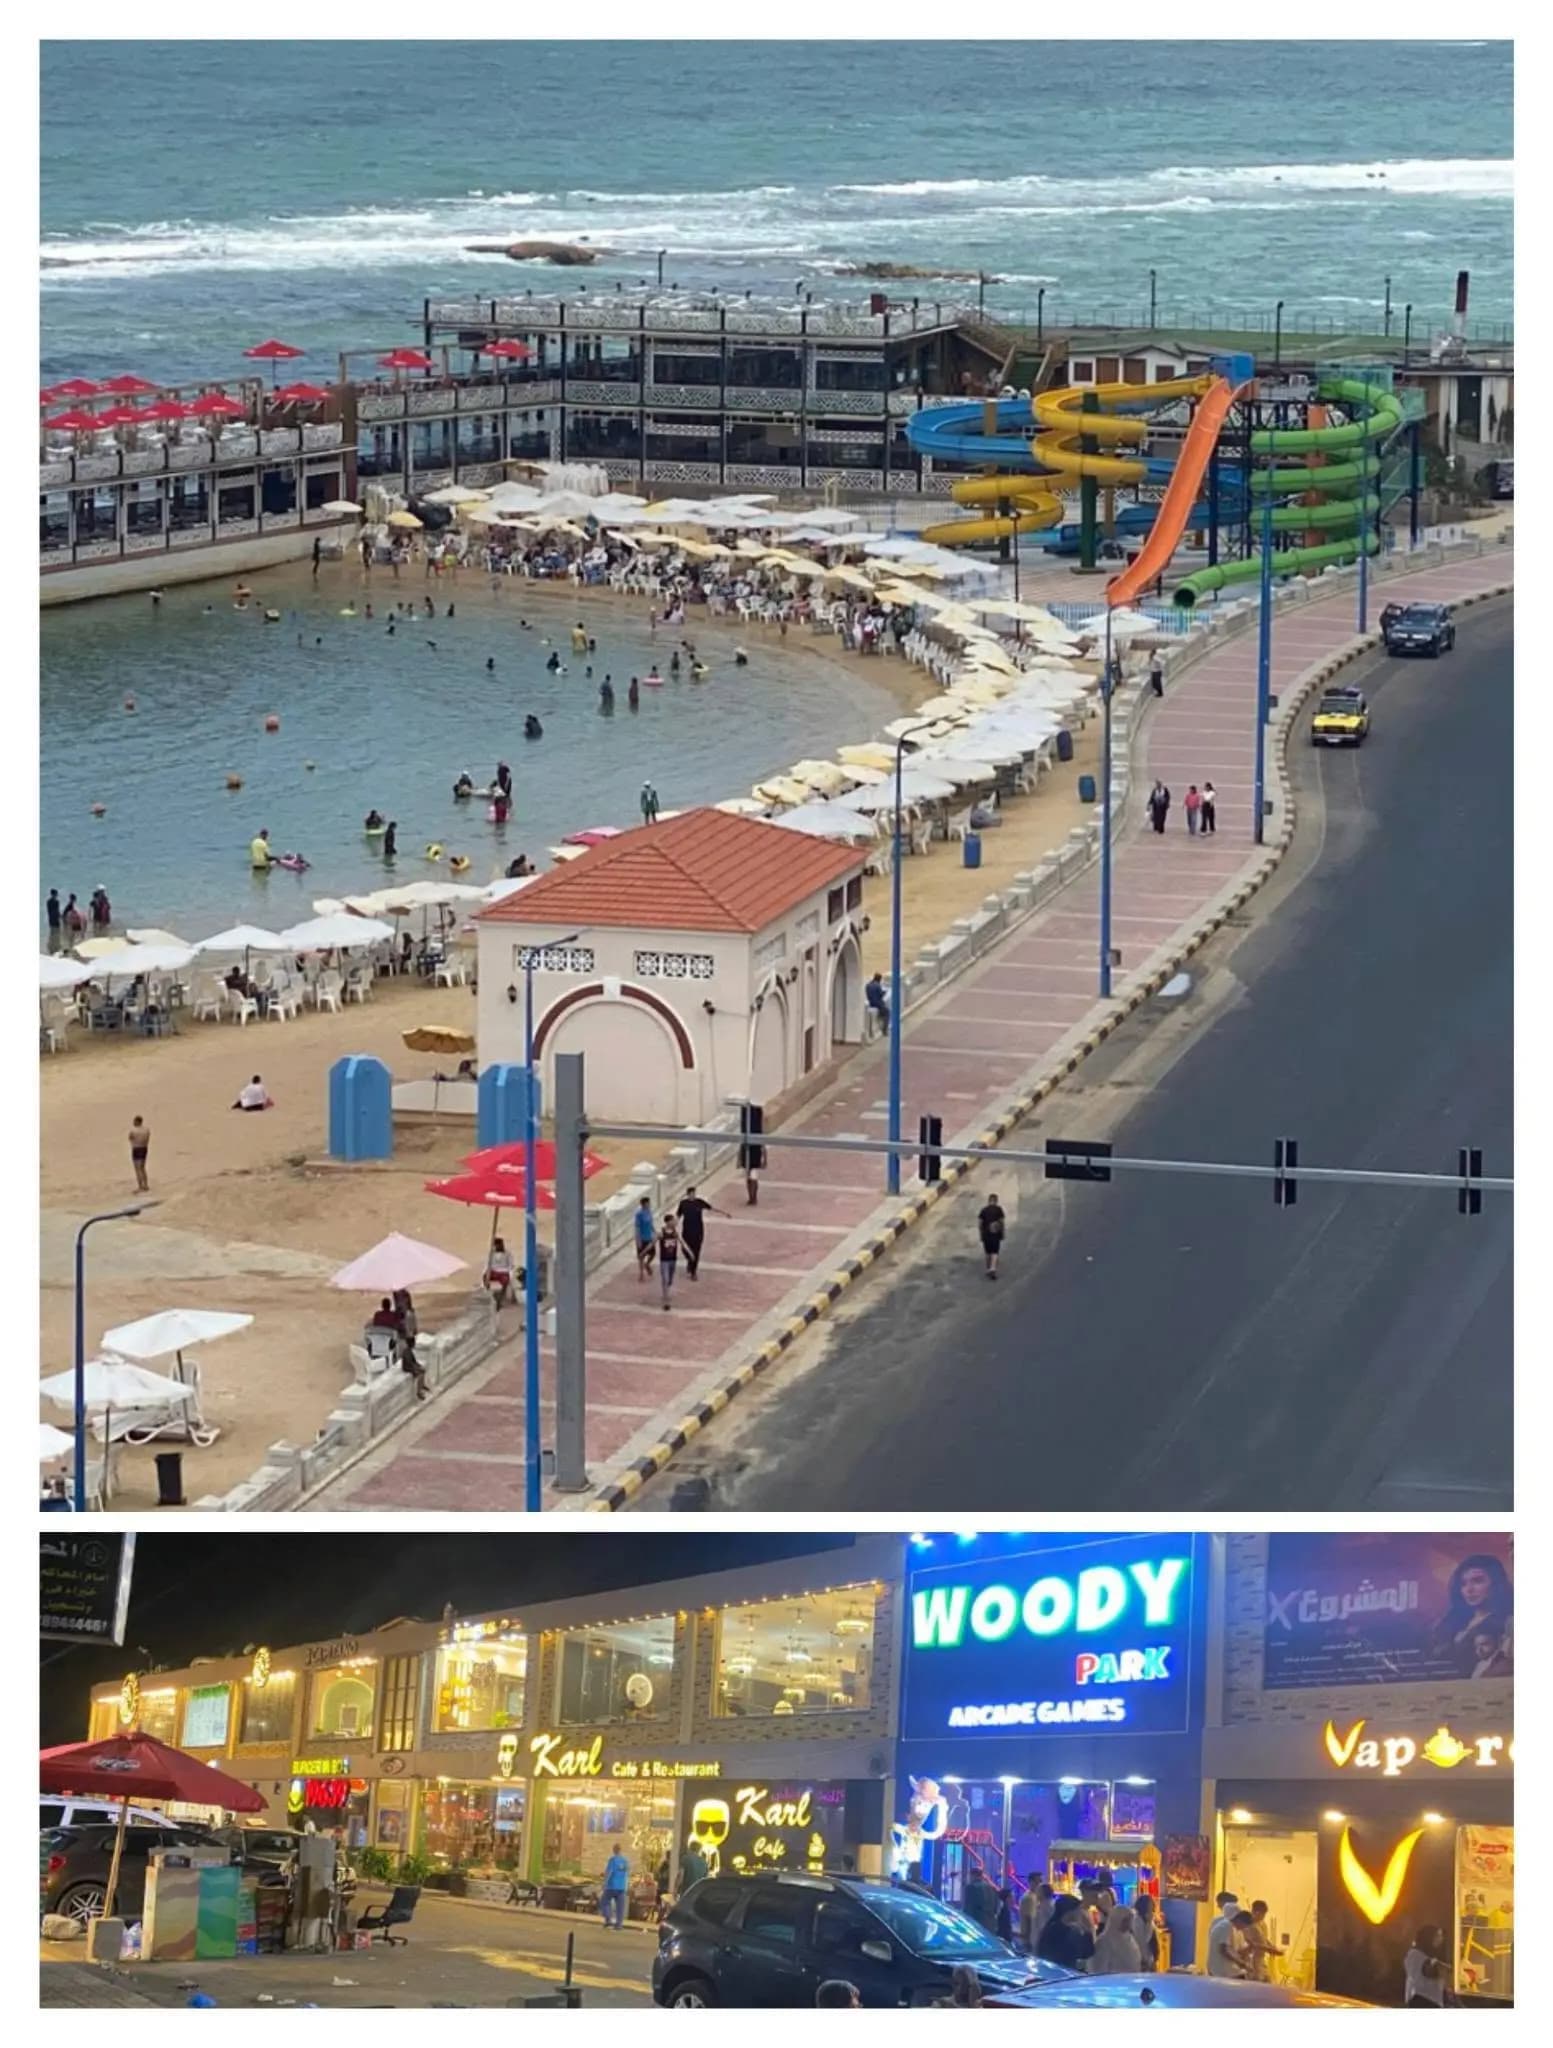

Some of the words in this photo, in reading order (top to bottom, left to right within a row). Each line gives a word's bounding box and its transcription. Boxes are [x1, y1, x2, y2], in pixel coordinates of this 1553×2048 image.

[912, 1558, 1190, 1648] WOODY
[1298, 1579, 1418, 1623] المشروع
[1076, 1647, 1171, 1685] PARK
[949, 1702, 1036, 1728] ARCADE
[1037, 1698, 1126, 1723] GAMES
[530, 1733, 603, 1777] Karl
[641, 1761, 650, 1777] &
[652, 1761, 720, 1777] Restaurant
[735, 1786, 812, 1827] Karl
